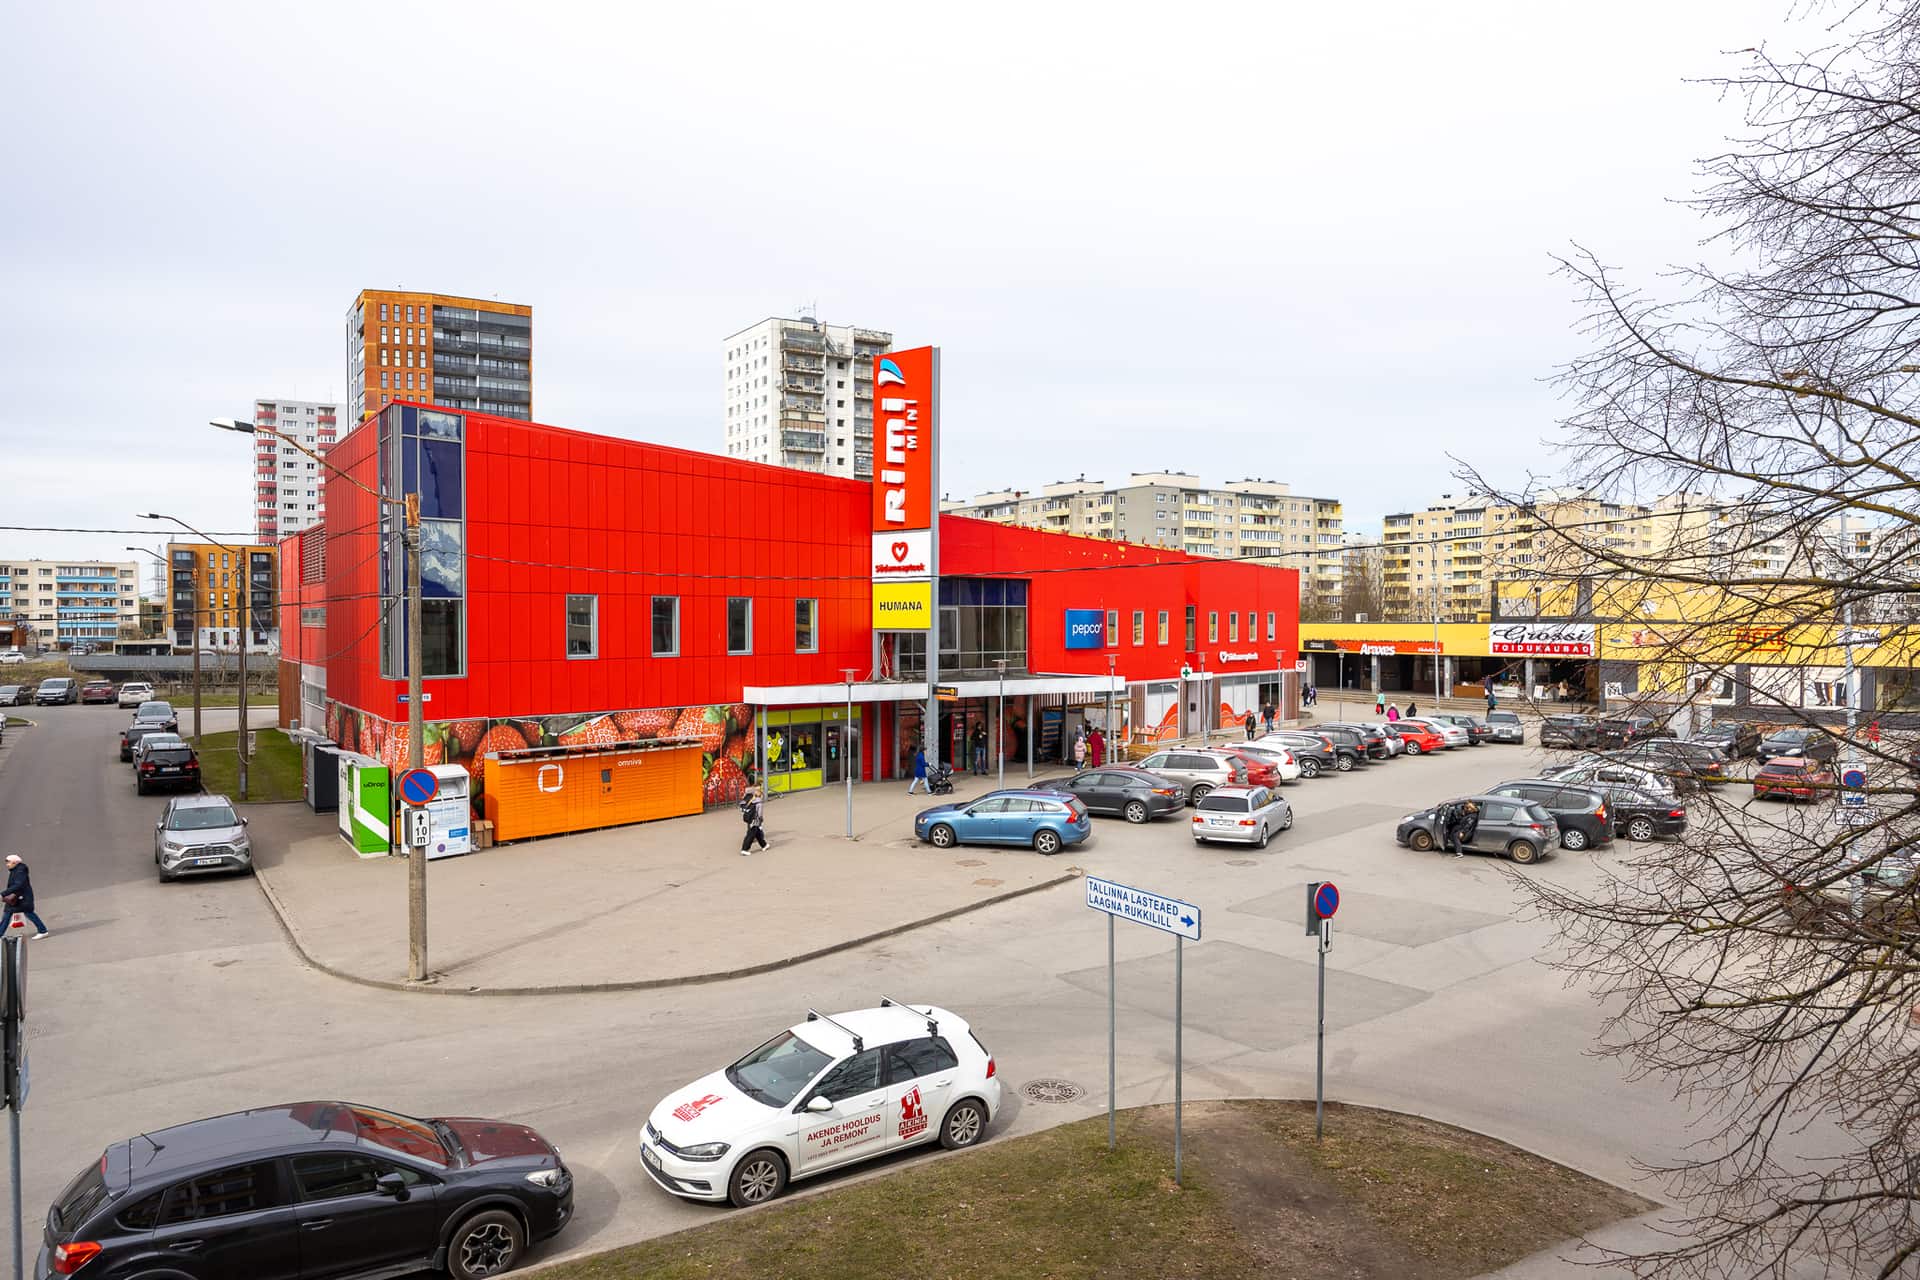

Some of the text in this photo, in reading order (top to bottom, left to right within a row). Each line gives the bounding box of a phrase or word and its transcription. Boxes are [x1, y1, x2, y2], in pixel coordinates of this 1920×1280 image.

[906, 399, 918, 450] MINI
[879, 601, 922, 611] HUMANA
[1072, 624, 1100, 637] pepco
[1360, 643, 1395, 656] Araxes
[618, 759, 642, 767] omniva
[363, 781, 385, 789] uDrop
[416, 827, 428, 836] 10
[416, 836, 426, 844] m
[1088, 881, 1179, 916] TALLINNA LASTEAED
[1088, 894, 1172, 928] LAAGNA RUKKILILL
[806, 1125, 841, 1143] AKENDE
[841, 1114, 881, 1132] HOOLDUS
[820, 1139, 832, 1148] JA
[833, 1126, 868, 1144] REMONT
